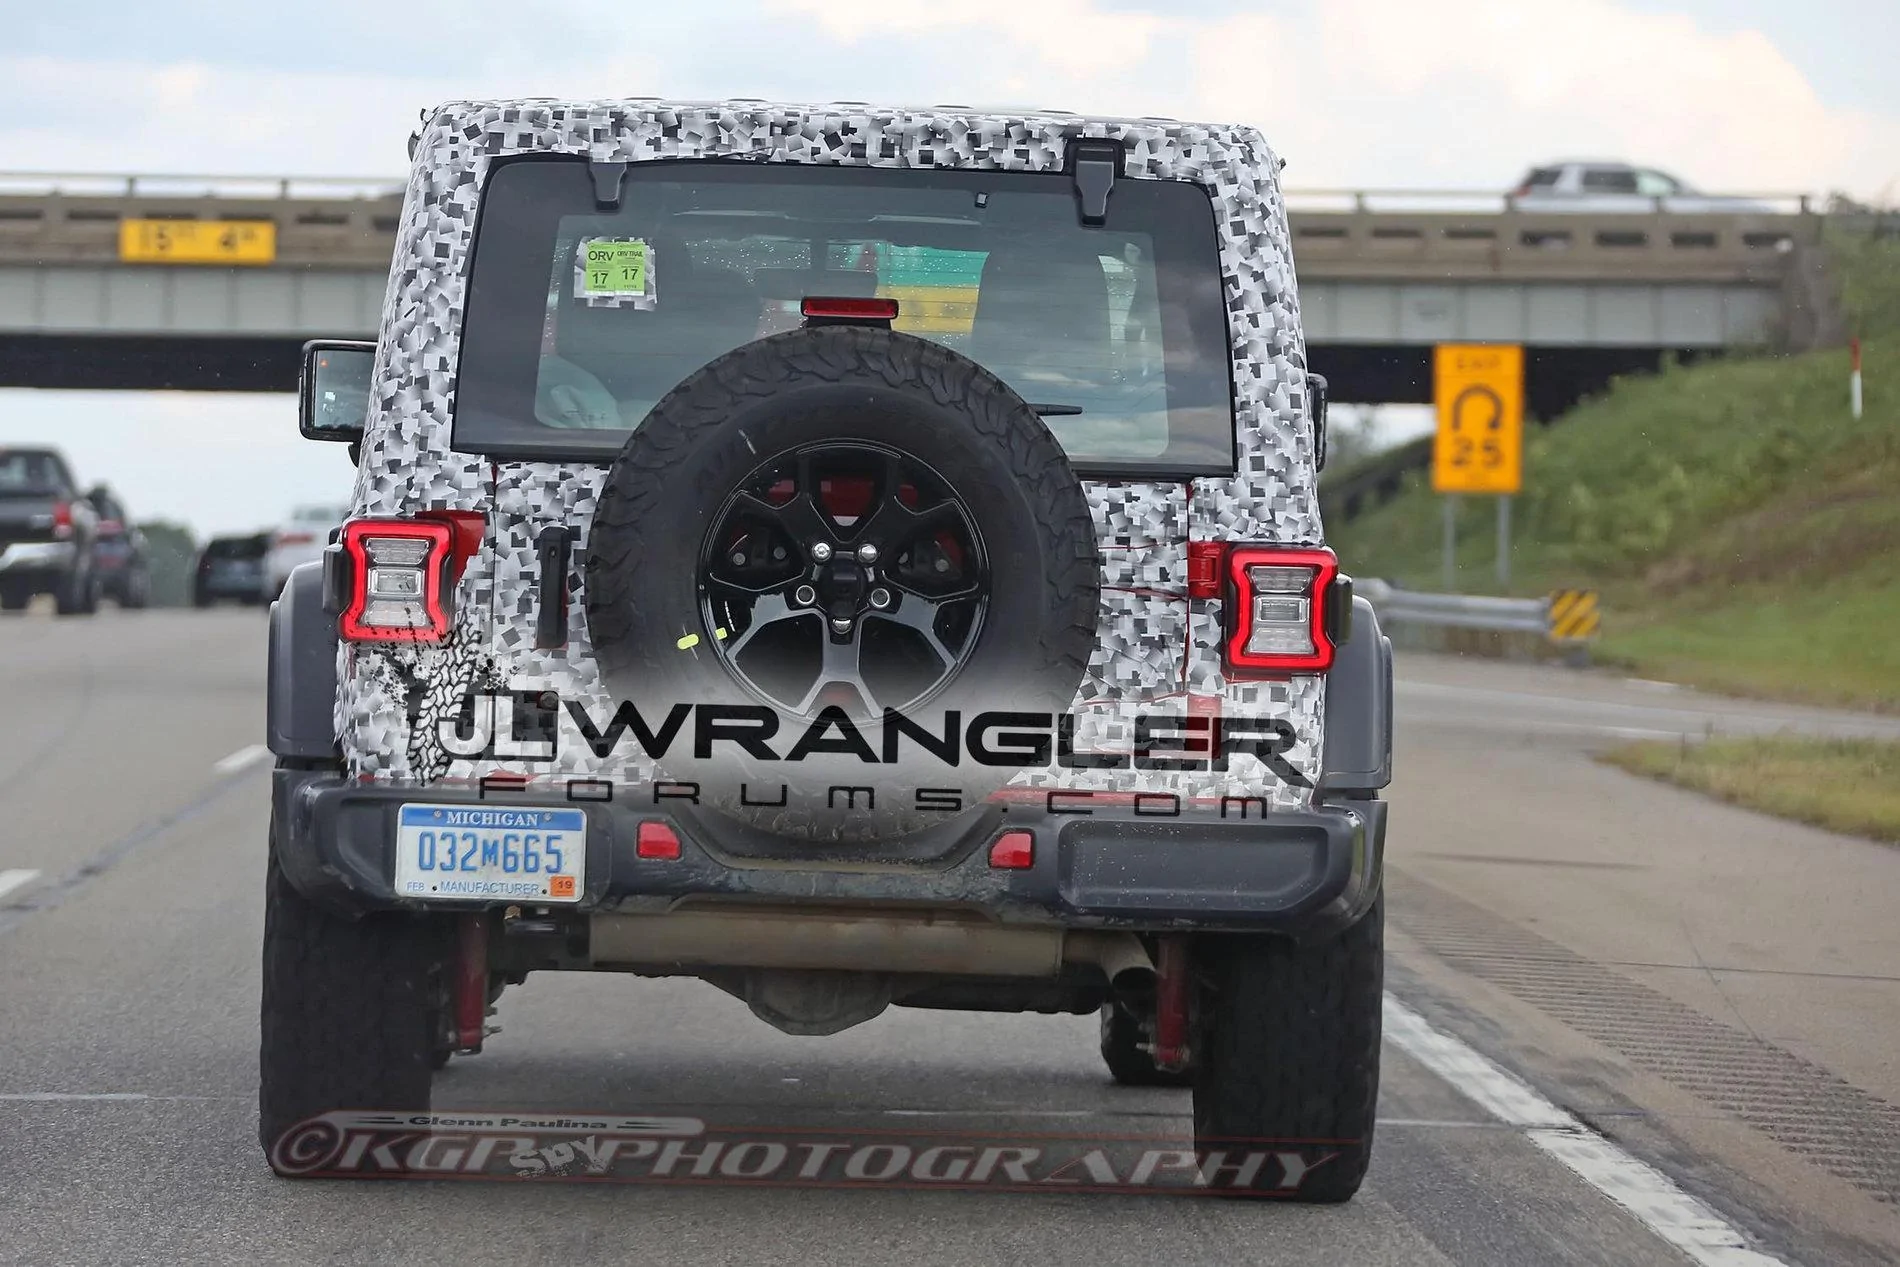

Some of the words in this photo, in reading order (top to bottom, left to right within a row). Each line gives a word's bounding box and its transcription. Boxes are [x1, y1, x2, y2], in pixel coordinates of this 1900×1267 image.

[588, 250, 615, 261] ORV
[592, 272, 608, 284] 17
[622, 268, 639, 280] 17
[1452, 436, 1504, 467] 25
[446, 810, 540, 828] MICHIGAN
[418, 830, 564, 874] 032M665
[406, 881, 425, 892] FEB
[440, 880, 540, 895] MANUFACTURER
[558, 880, 573, 889] 19
